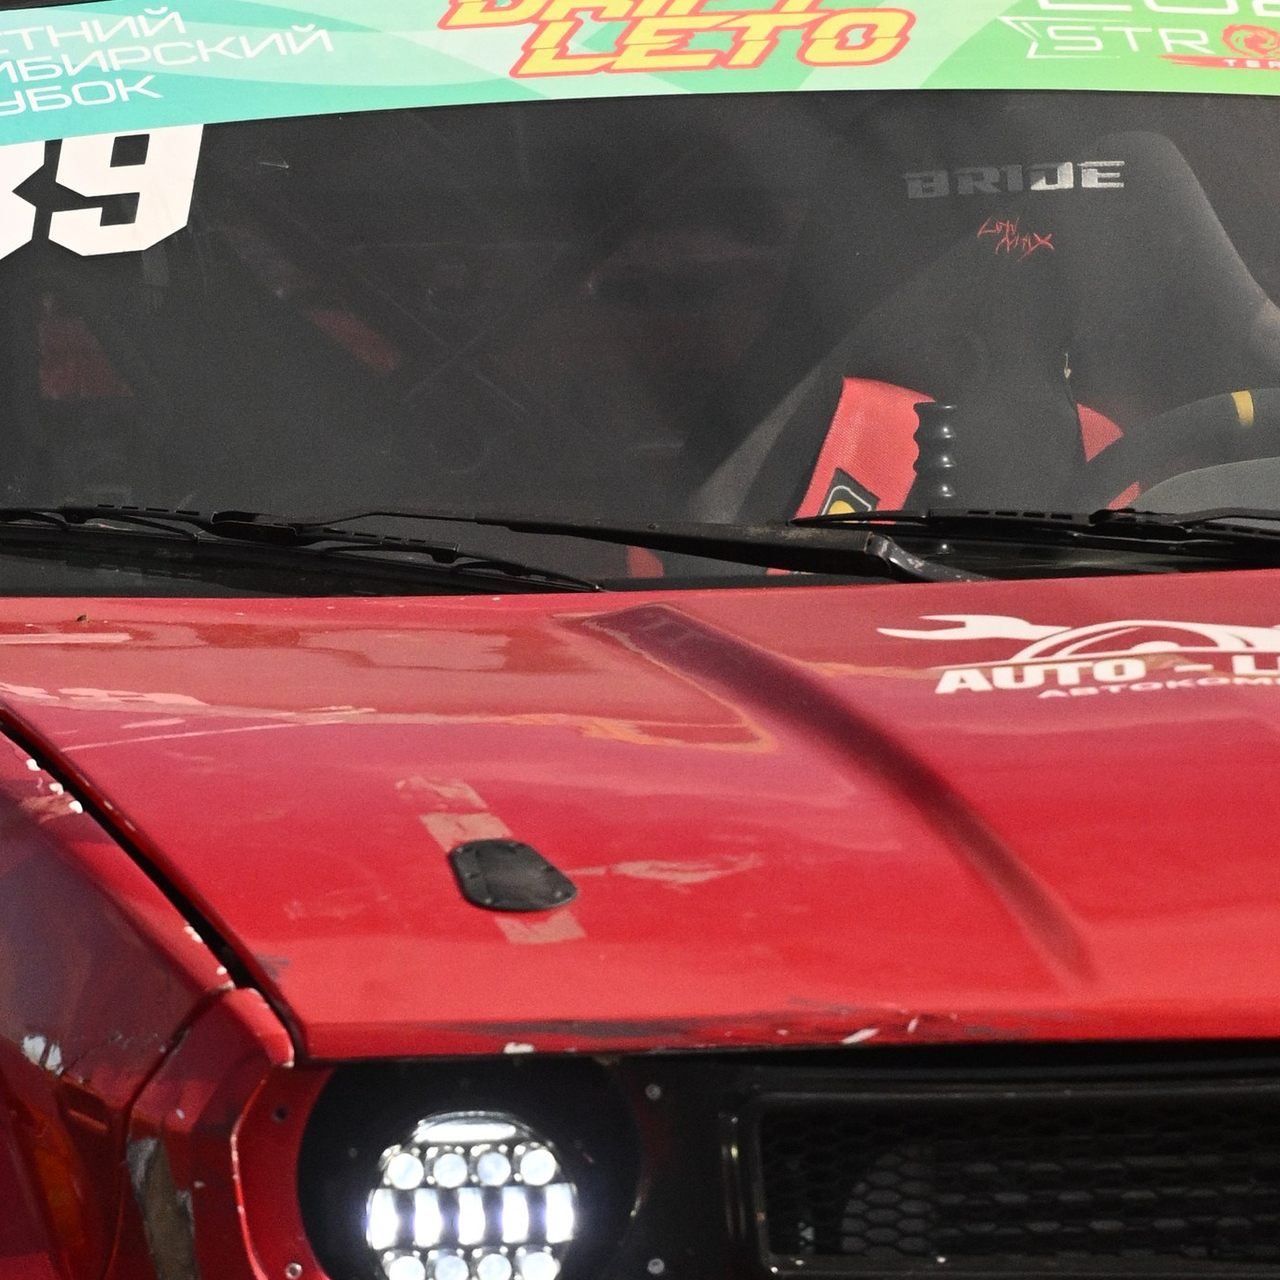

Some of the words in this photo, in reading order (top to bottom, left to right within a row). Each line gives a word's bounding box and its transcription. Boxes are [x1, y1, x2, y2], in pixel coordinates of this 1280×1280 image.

[508, 8, 917, 78] LETO
[904, 160, 1125, 199] BRIDE
[935, 658, 1146, 694] AUTO
